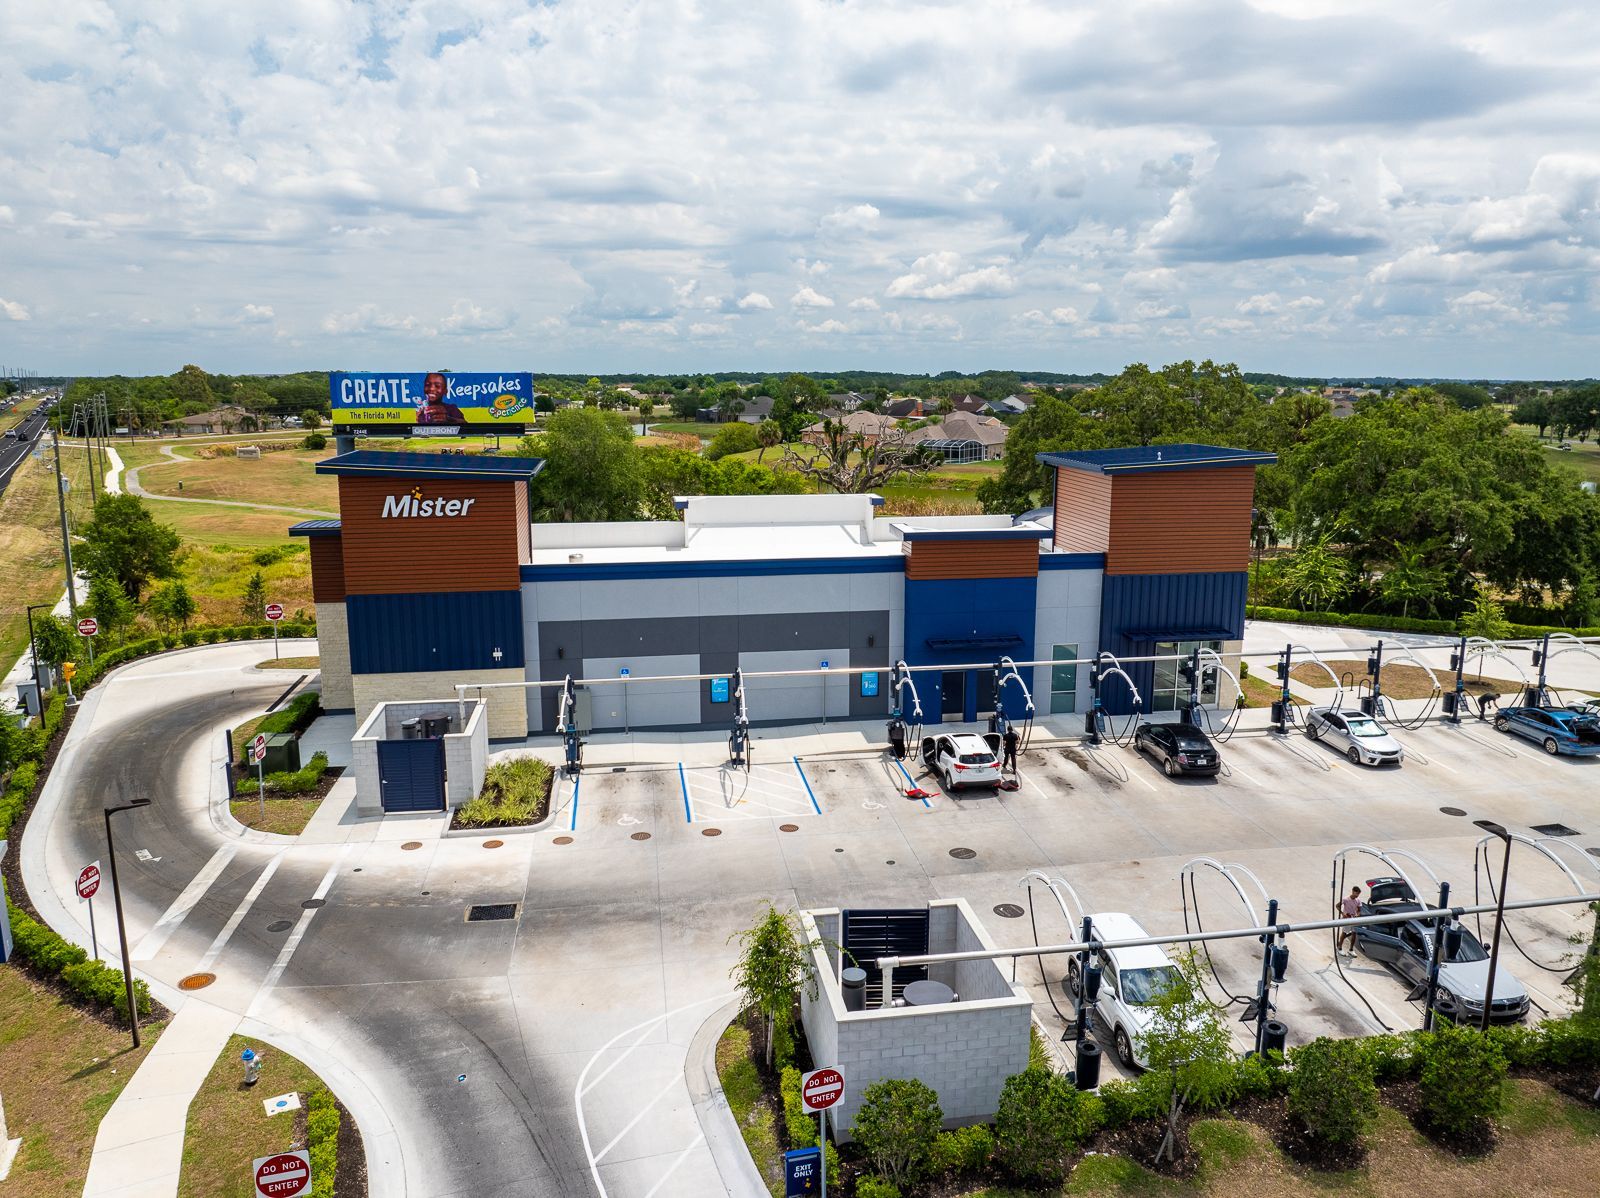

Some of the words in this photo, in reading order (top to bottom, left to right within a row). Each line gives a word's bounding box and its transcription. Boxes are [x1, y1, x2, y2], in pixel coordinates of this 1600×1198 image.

[341, 379, 411, 403] CREATE
[446, 376, 521, 400] Keepsakes
[381, 494, 475, 518] Mister
[81, 874, 87, 882] DO
[88, 868, 97, 877] NOT
[83, 883, 97, 895] ENTER
[809, 1079, 820, 1087] DO
[823, 1074, 838, 1084] NOT
[812, 1092, 836, 1104] ENTER
[263, 1165, 276, 1174] DO
[282, 1160, 301, 1170] NOT
[793, 1169, 813, 1178] ONLY
[795, 1163, 812, 1171] EXIT
[268, 1180, 299, 1193] ENTER
